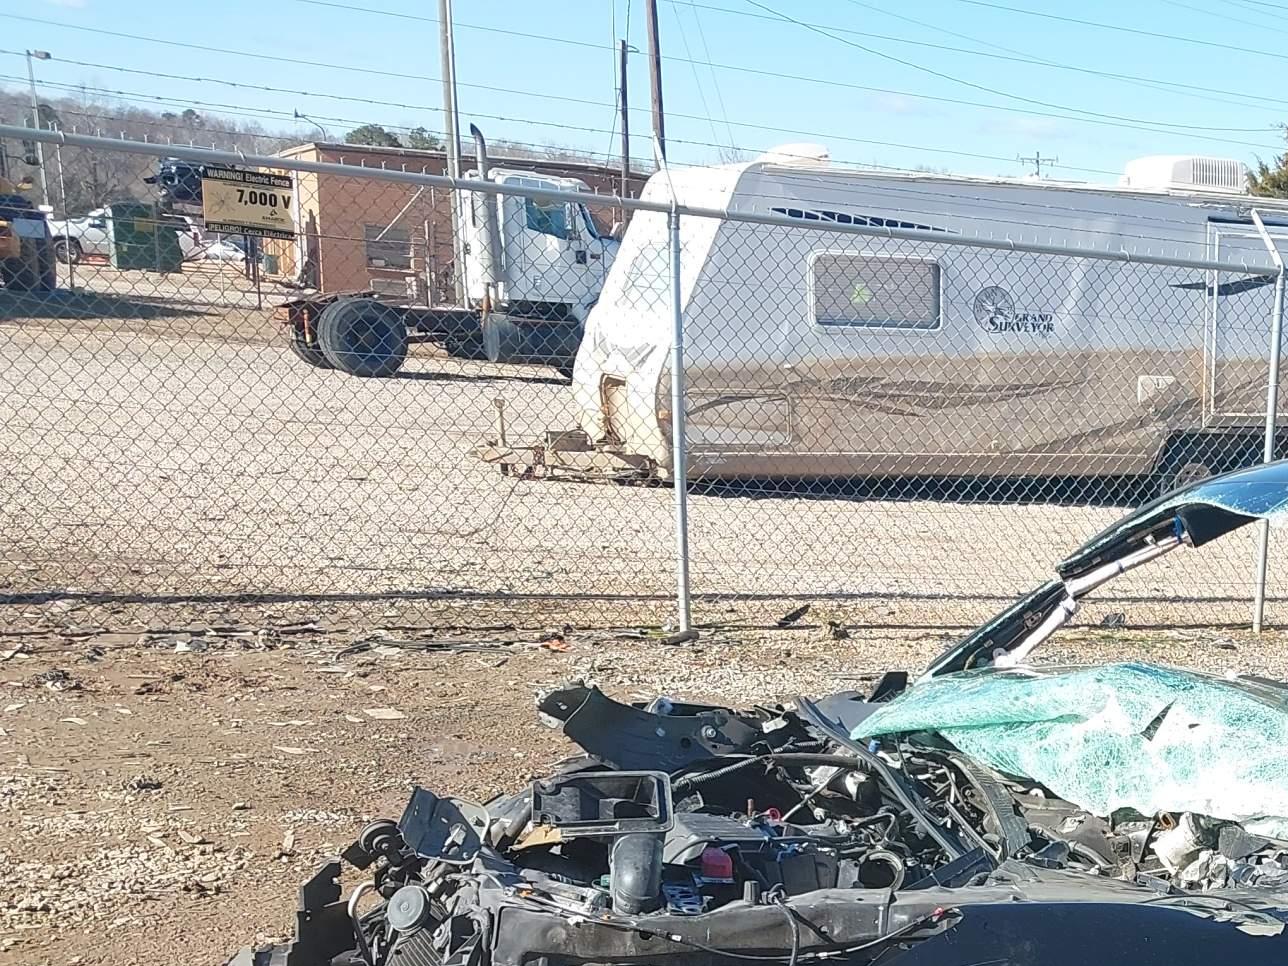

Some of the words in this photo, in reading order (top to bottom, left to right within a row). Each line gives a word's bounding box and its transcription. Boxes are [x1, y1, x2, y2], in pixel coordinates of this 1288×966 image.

[207, 168, 243, 181] WARNING!
[245, 173, 269, 184] Electric
[270, 176, 290, 187] Fence
[236, 188, 278, 208] 7,000
[281, 195, 292, 210] V
[988, 316, 1054, 334] SURVEYOR
[1014, 313, 1053, 323] GRAND
